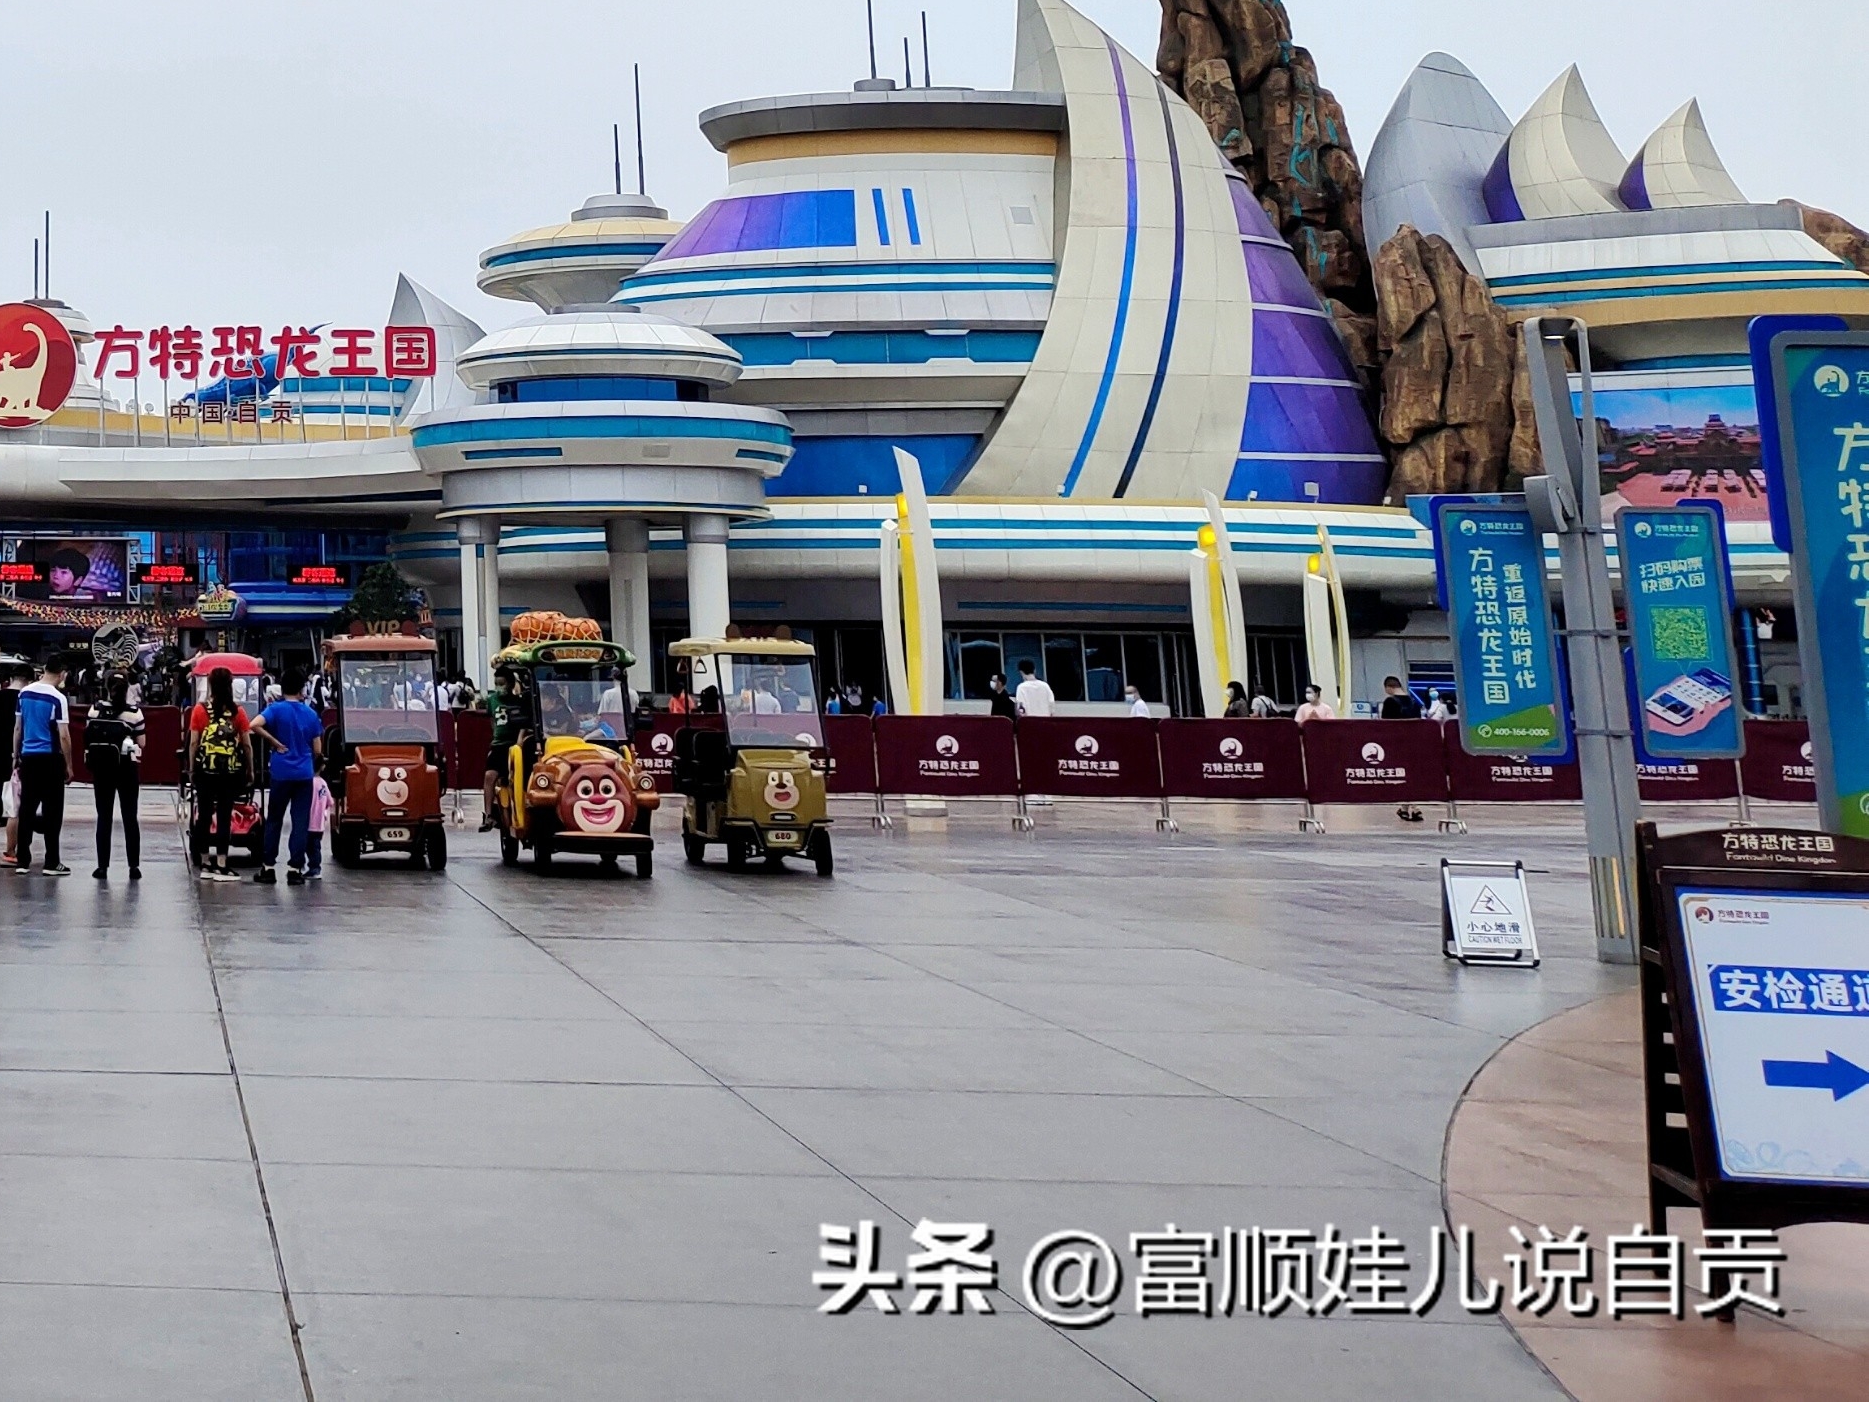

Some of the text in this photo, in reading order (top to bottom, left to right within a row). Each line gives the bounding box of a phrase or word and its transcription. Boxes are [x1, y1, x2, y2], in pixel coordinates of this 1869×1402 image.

[93, 324, 436, 381] 方特恐龙王国
[1639, 556, 1704, 579] 扫码购票
[1640, 571, 1706, 594] 快速入园
[366, 619, 401, 636] VIP
[1468, 547, 1511, 706] 方特恐龙王国
[1502, 563, 1537, 690] 重返原始时代
[918, 759, 980, 770] 方特恐龙王国
[1202, 762, 1264, 772] 方特恐龙王国
[1722, 833, 1835, 852] 方特恐龙王国
[1467, 921, 1520, 933] 小心地滑
